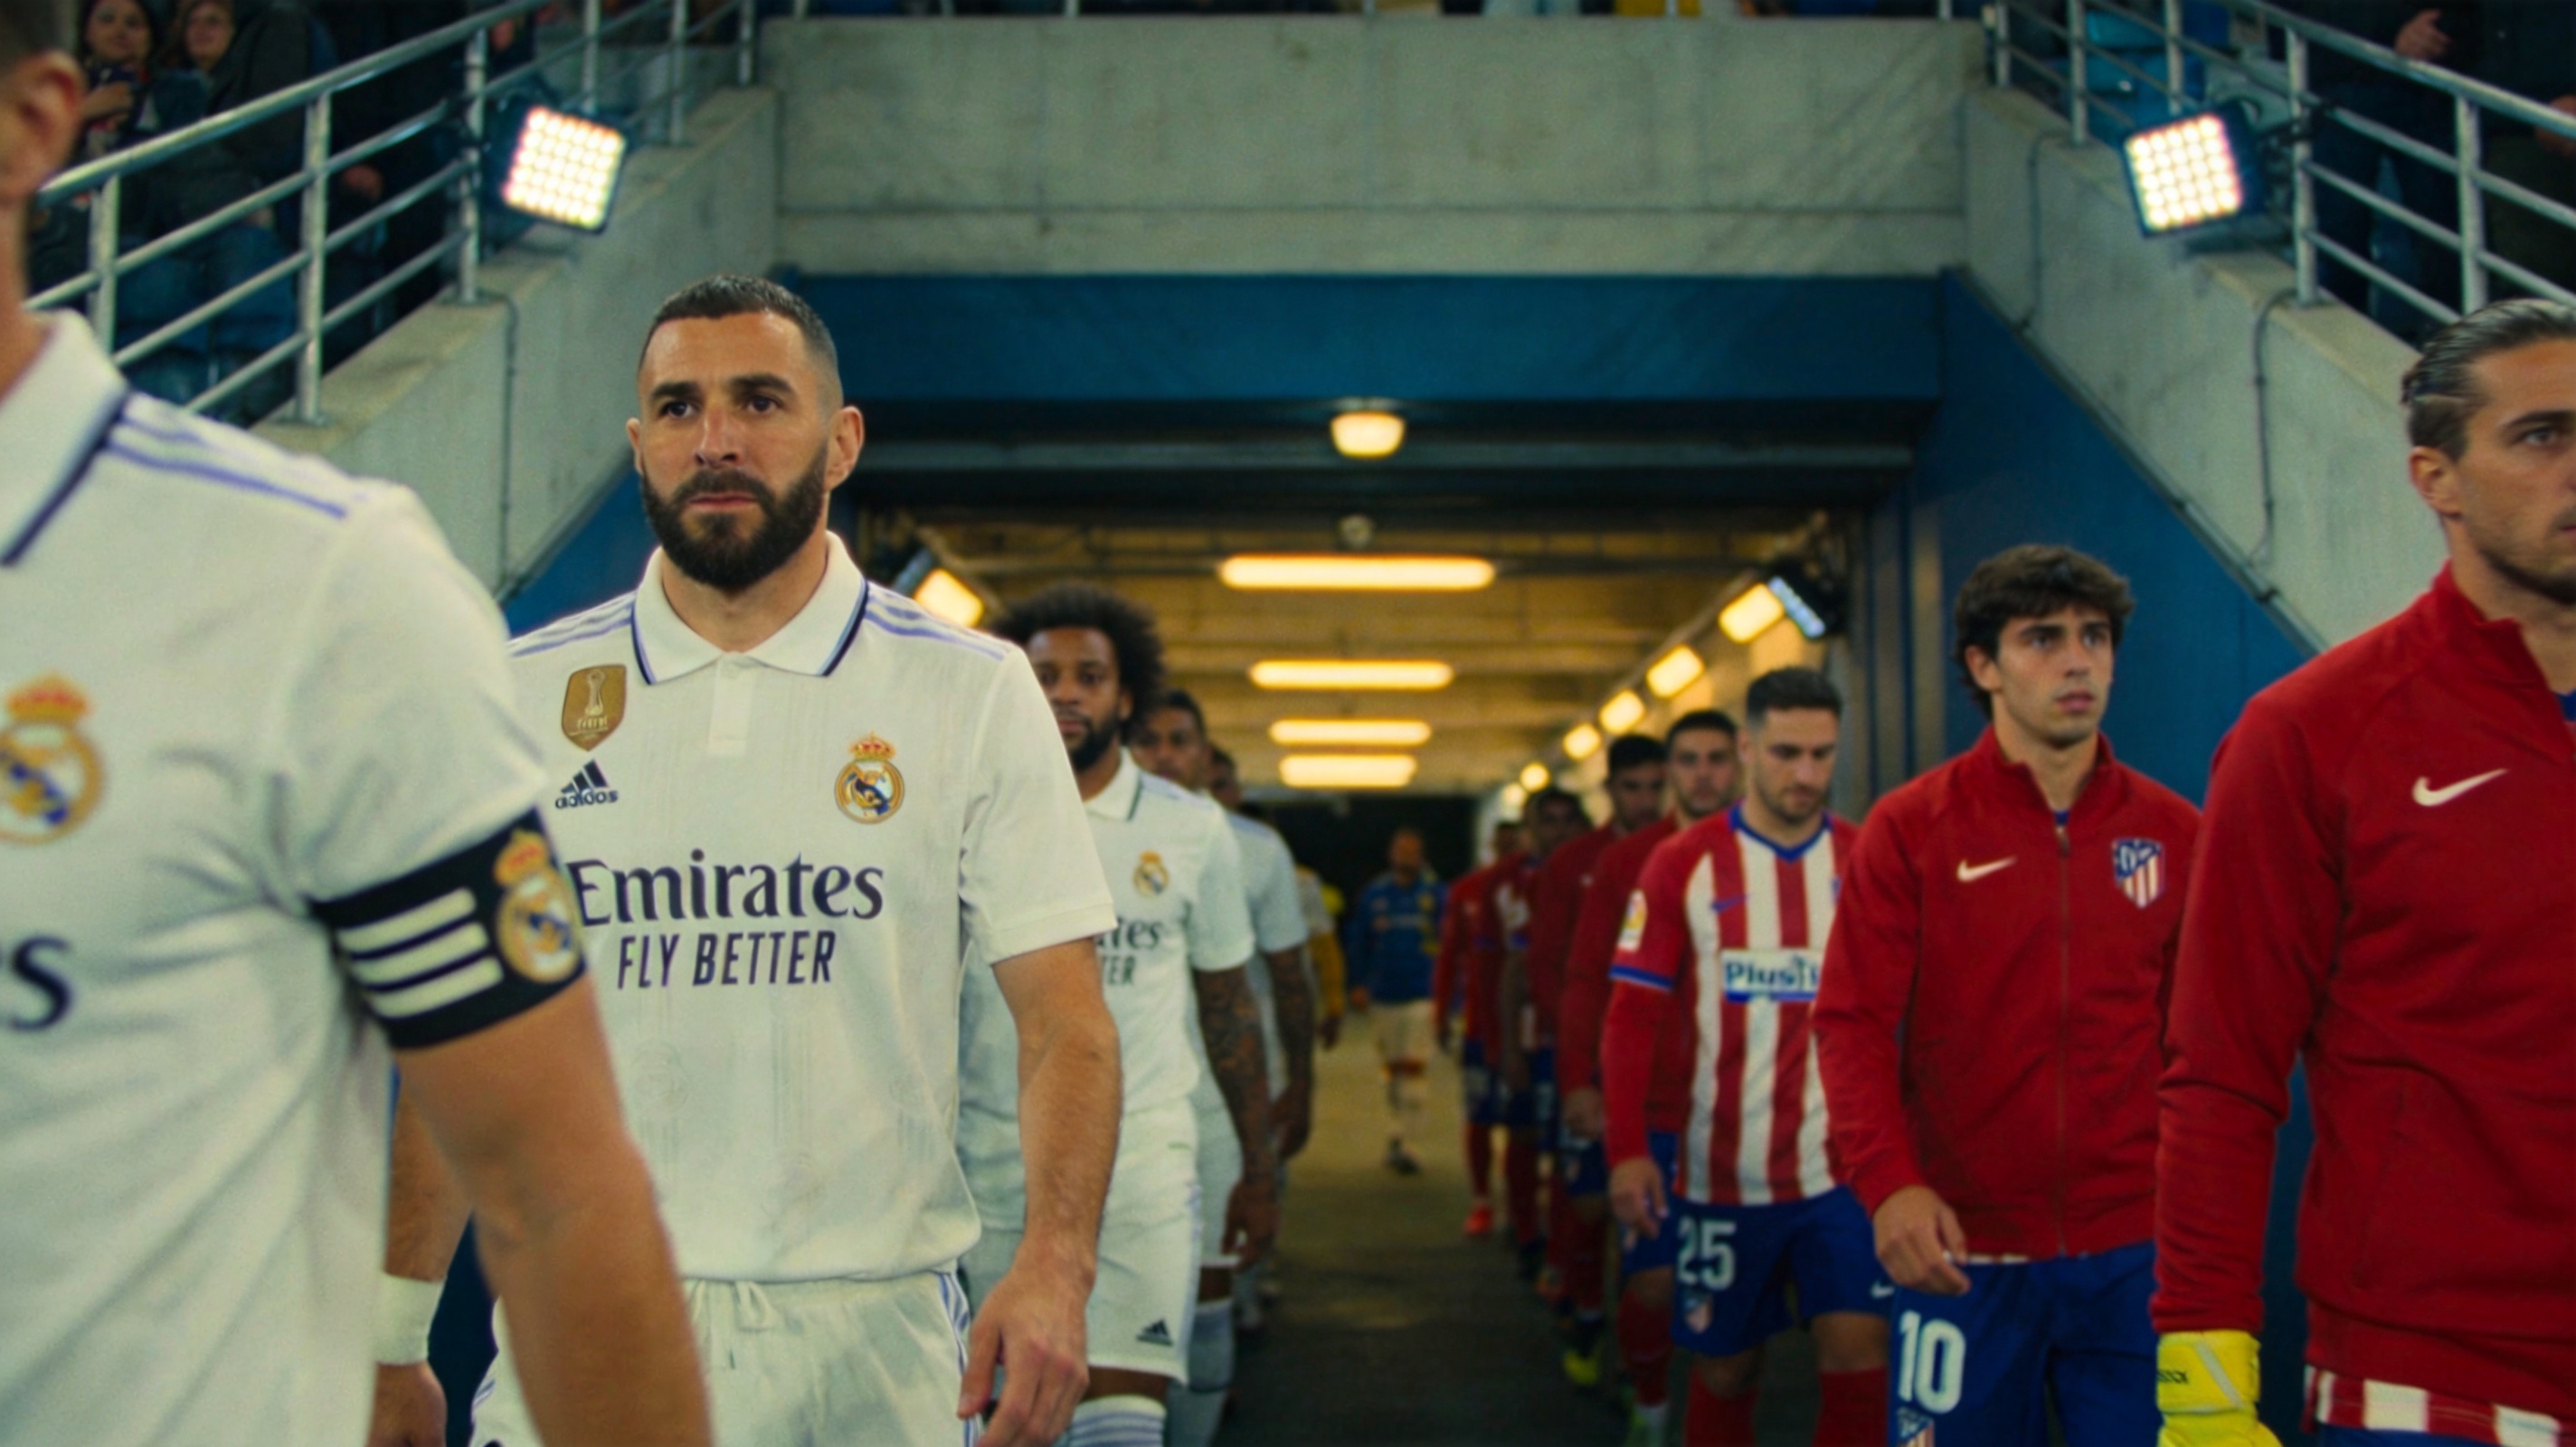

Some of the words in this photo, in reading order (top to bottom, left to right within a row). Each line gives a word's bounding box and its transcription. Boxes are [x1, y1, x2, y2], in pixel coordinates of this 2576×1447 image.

[566, 848, 884, 927] Emirates
[618, 933, 680, 989] FLY
[693, 931, 836, 986] BETTER
[1677, 1215, 1737, 1291] 25
[1899, 1310, 1965, 1414] 10
